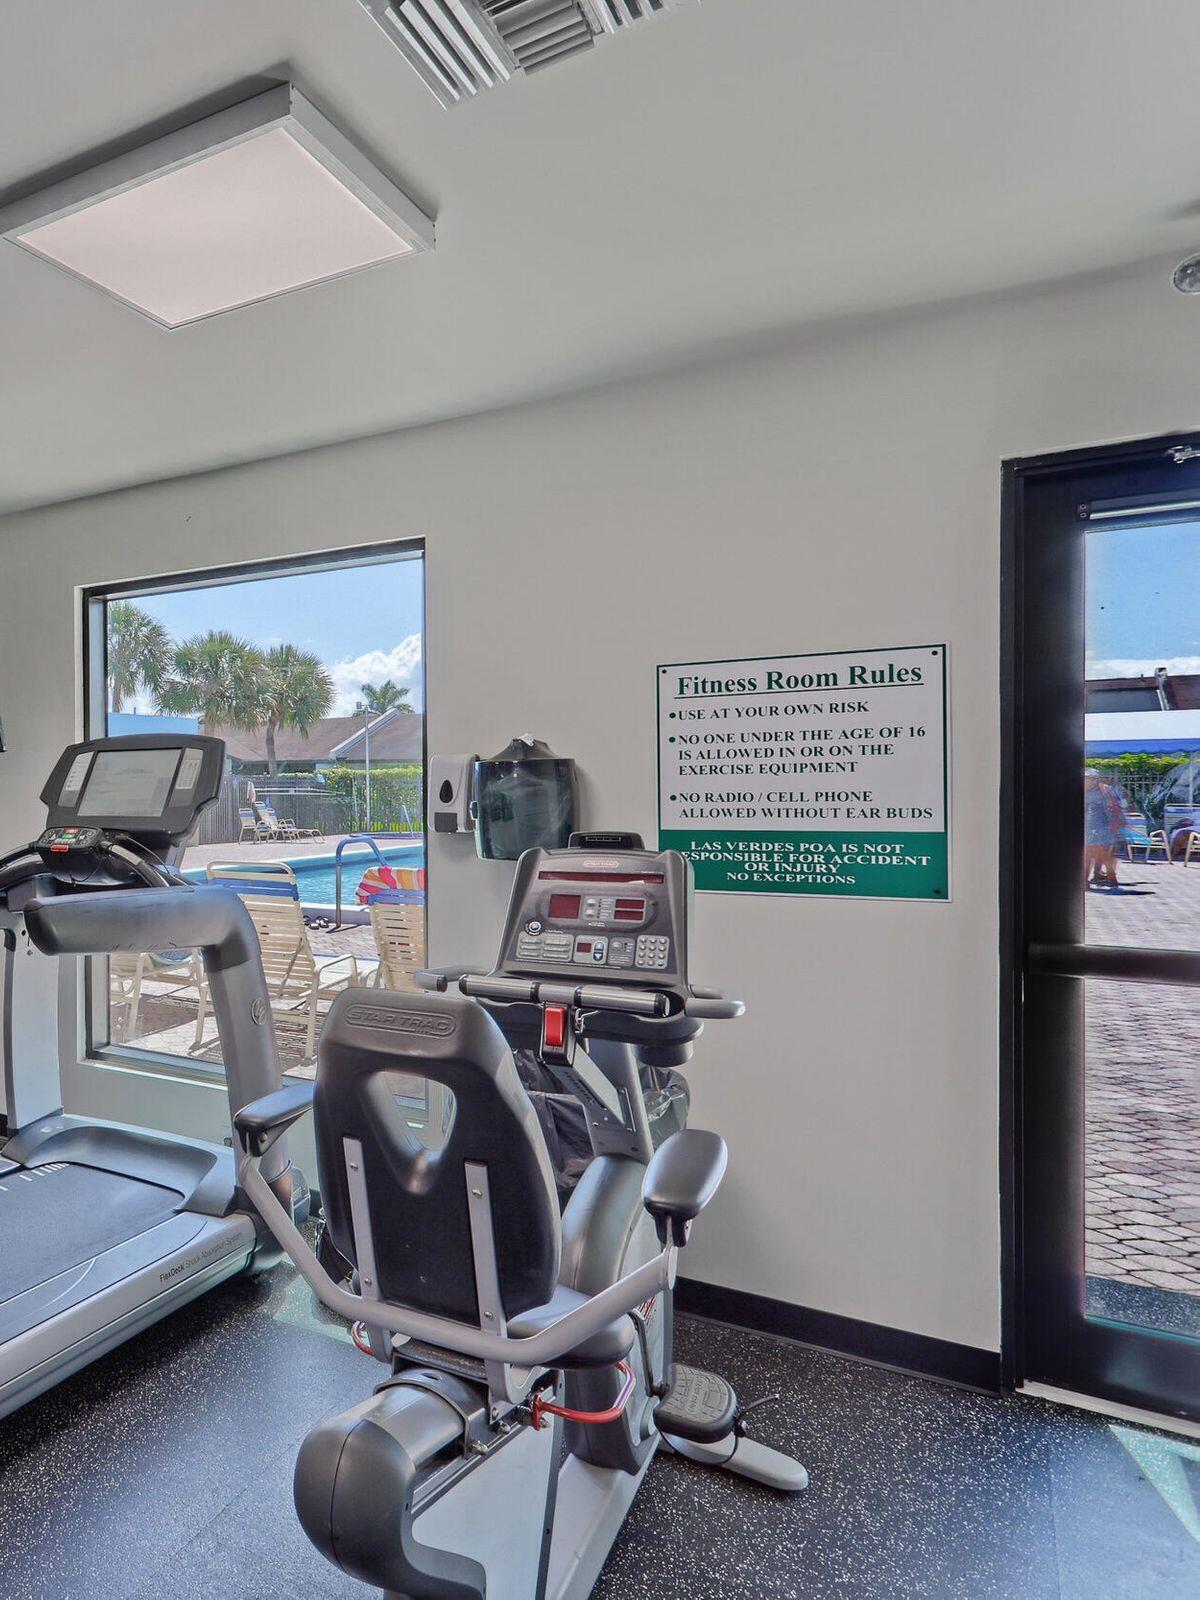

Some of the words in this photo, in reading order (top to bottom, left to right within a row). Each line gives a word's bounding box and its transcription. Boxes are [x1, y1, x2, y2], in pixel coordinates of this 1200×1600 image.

[678, 676, 757, 695] Fitness
[766, 671, 838, 690] Room
[848, 664, 922, 685] Rules
[678, 709, 705, 720] USE
[710, 707, 730, 719] AT
[735, 706, 779, 718] YOUR
[784, 704, 823, 715] OWN
[829, 701, 870, 713] RISK
[679, 734, 700, 745] NO
[704, 733, 736, 744] ONE
[740, 731, 795, 743] UNDER
[799, 729, 833, 740] THE
[839, 728, 874, 740] AGE
[879, 726, 903, 738] OF
[909, 726, 926, 737] 16
[679, 750, 692, 761] IS
[696, 747, 774, 760] ALLOWED
[779, 747, 796, 758] IN
[800, 746, 824, 757] OR
[829, 745, 853, 756] ON
[858, 744, 894, 756] THE
[679, 763, 754, 776] EXERCISE
[758, 761, 858, 776] EQUIPMENT
[679, 793, 700, 803] NO
[705, 792, 754, 803] RADIO
[766, 792, 810, 803] CELL
[815, 791, 873, 802] PHONE
[679, 808, 757, 819] ALLOWED
[761, 808, 841, 819] WITHOUT
[846, 808, 881, 819] EAR
[886, 808, 933, 819] BUDS
[691, 841, 721, 851] LAS
[726, 841, 794, 852] VERDES
[799, 843, 836, 853] POA
[841, 844, 859, 854] IS
[863, 844, 904, 854] NOT
[681, 851, 784, 863] ESPONSIBLE
[789, 853, 826, 863] FOR
[830, 855, 931, 866] ACCIDENT
[744, 862, 770, 872] OR
[774, 863, 841, 874] INJURY
[726, 872, 749, 881] NO
[753, 873, 856, 885] EXCEPTIONS
